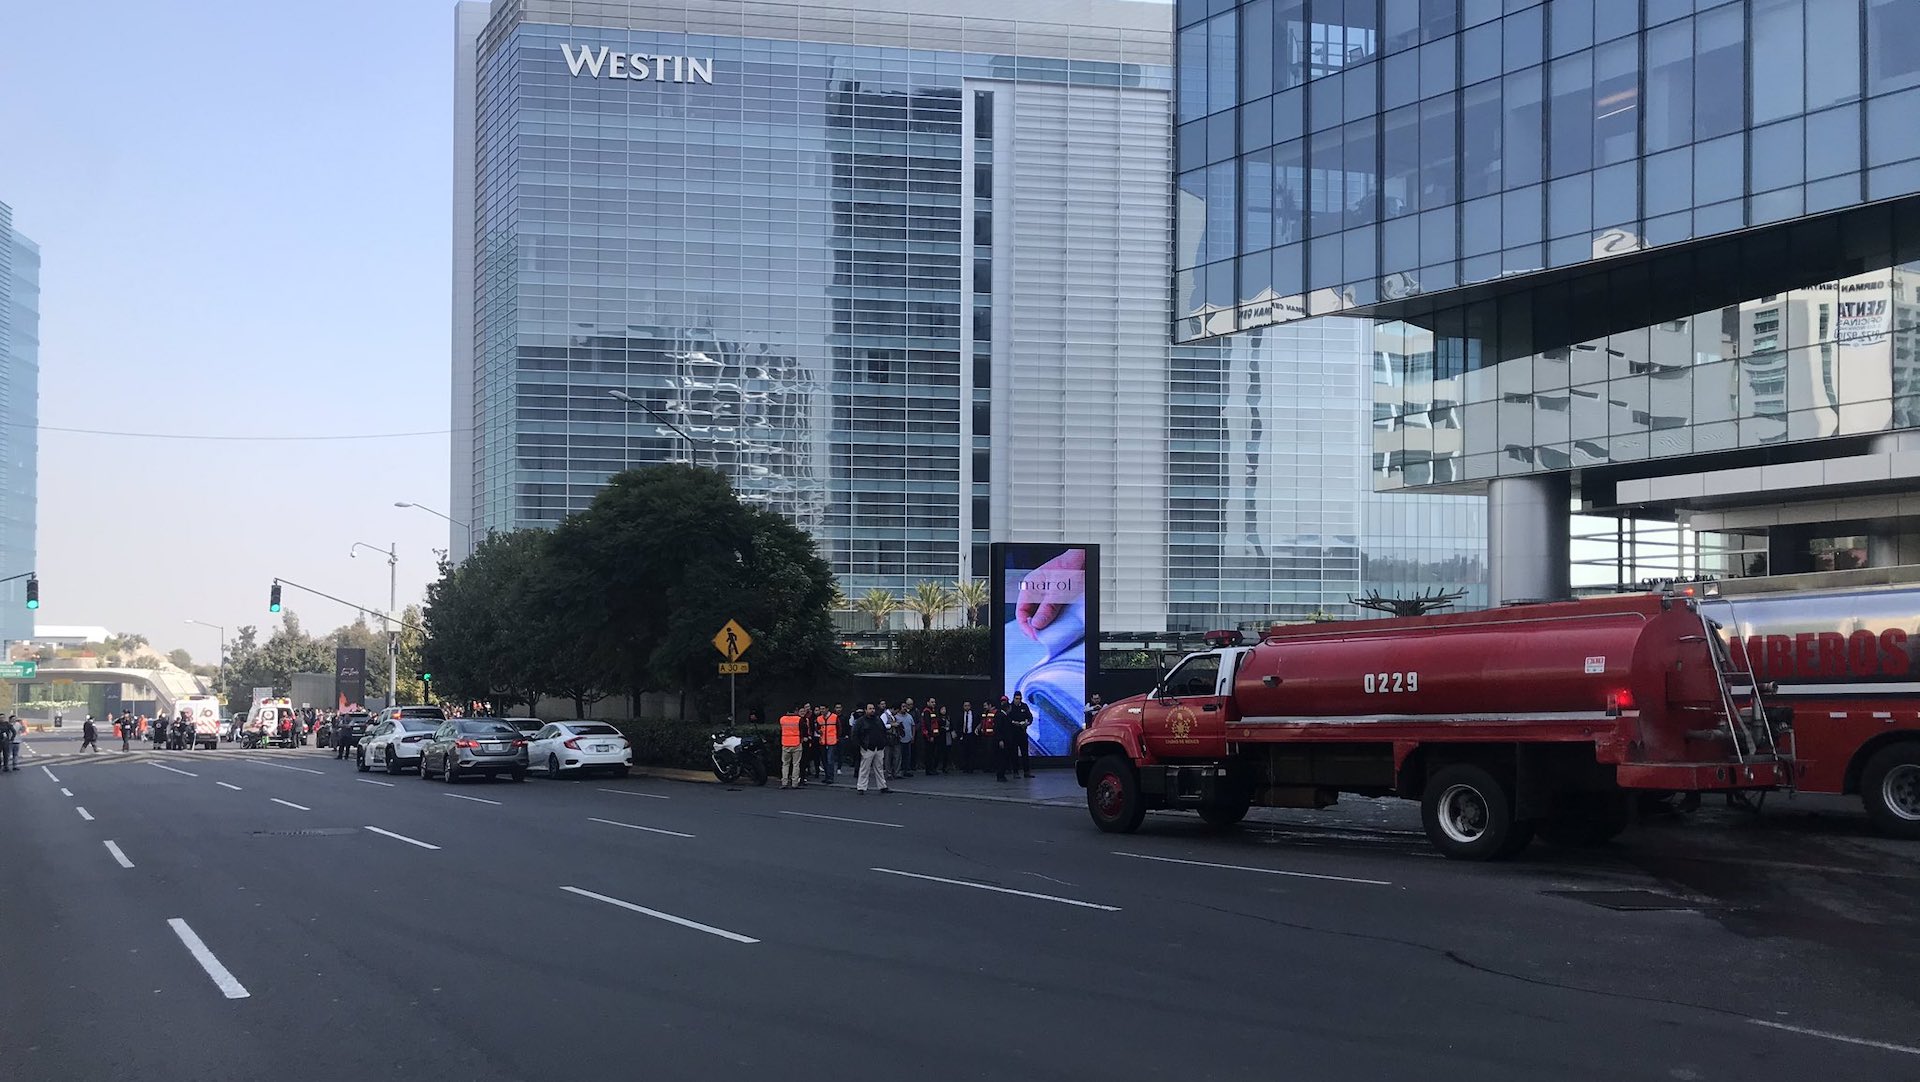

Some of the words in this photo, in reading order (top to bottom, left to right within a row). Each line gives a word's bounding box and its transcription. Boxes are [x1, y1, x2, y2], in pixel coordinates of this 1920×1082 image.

[560, 43, 713, 85] WESTIN
[1730, 628, 1911, 679] MBEROS
[1364, 672, 1418, 693] 0229
